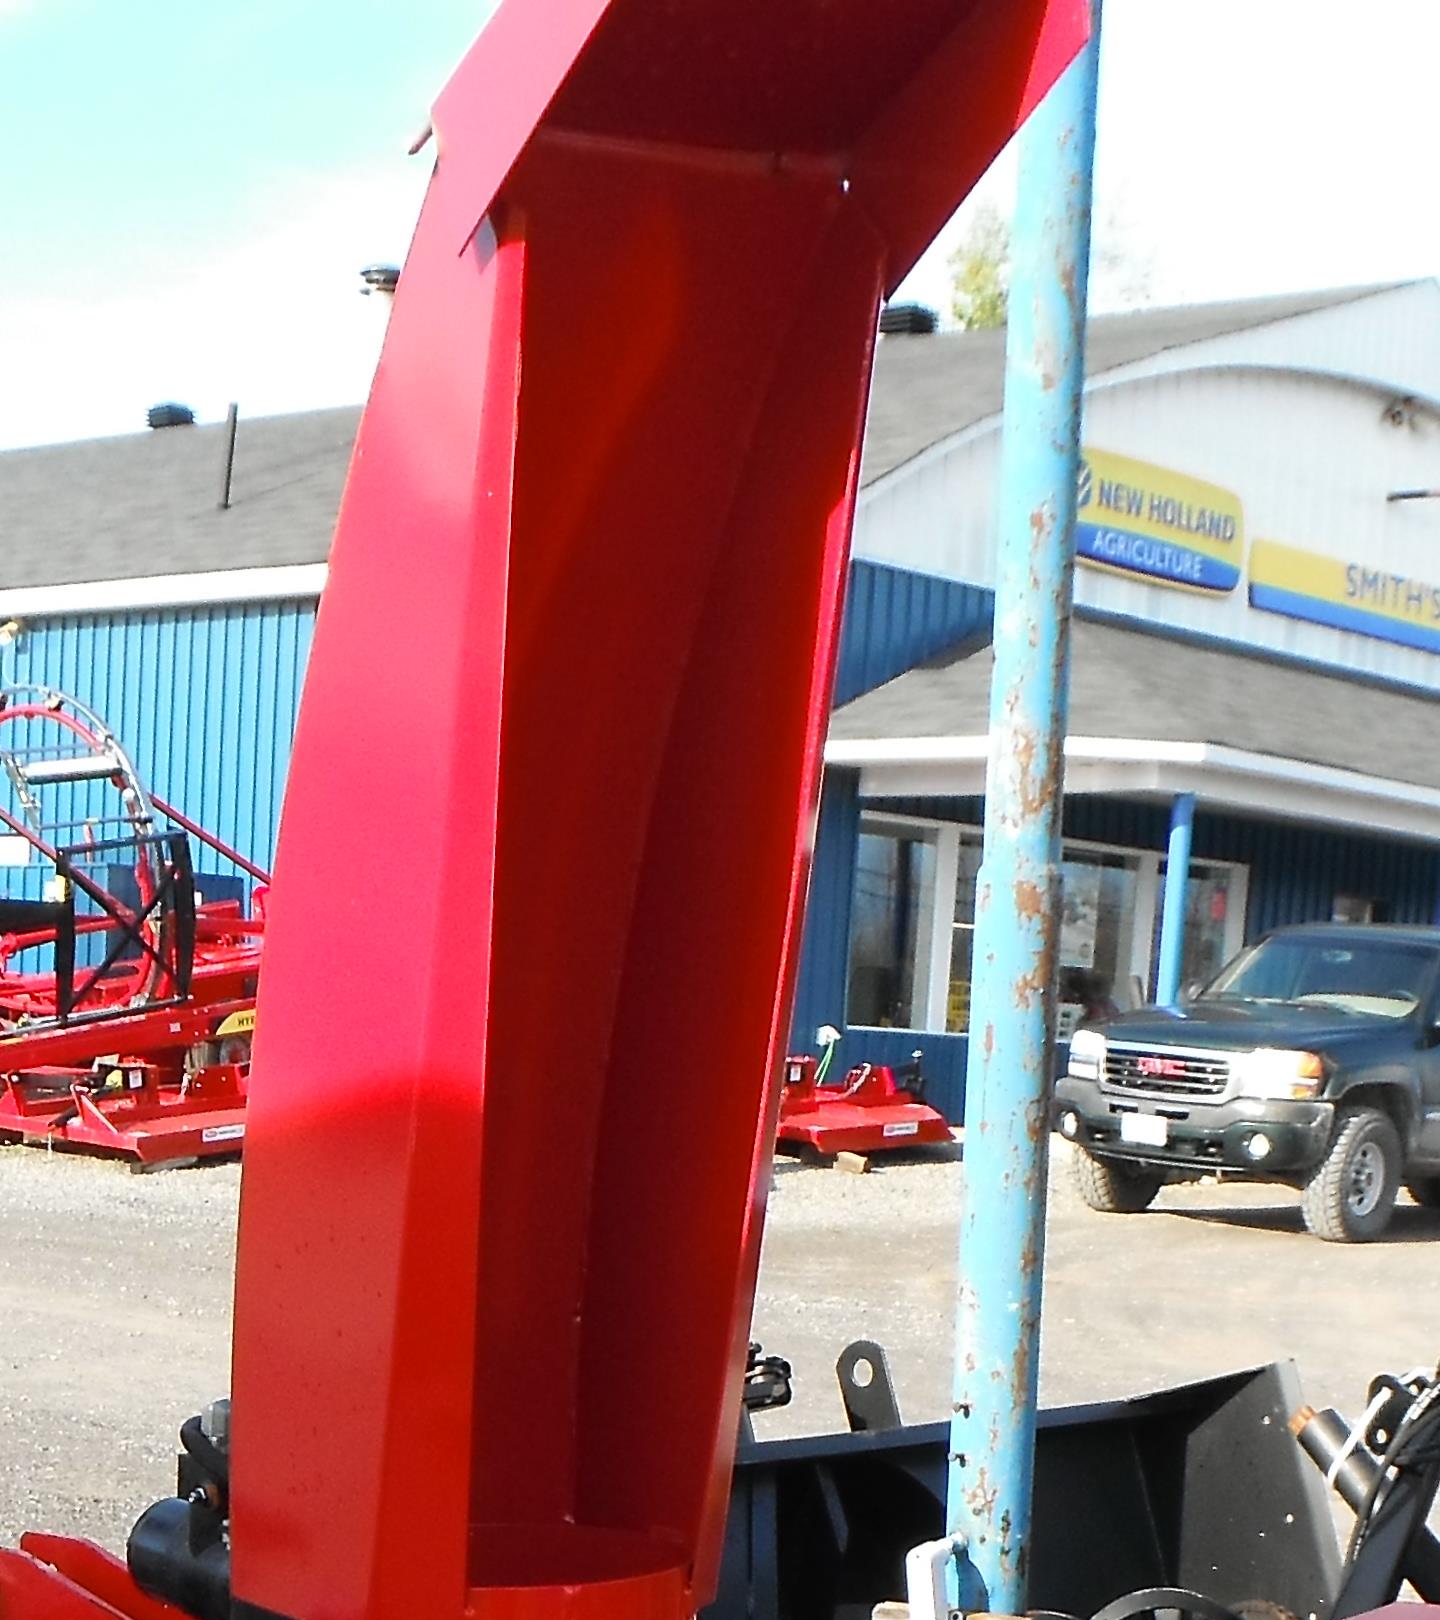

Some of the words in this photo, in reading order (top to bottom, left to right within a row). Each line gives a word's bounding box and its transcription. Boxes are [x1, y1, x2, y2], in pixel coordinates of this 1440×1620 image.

[1098, 478, 1144, 518] NEW
[1148, 492, 1236, 543] HOLLAND
[1092, 529, 1203, 579] AGRICULTURE
